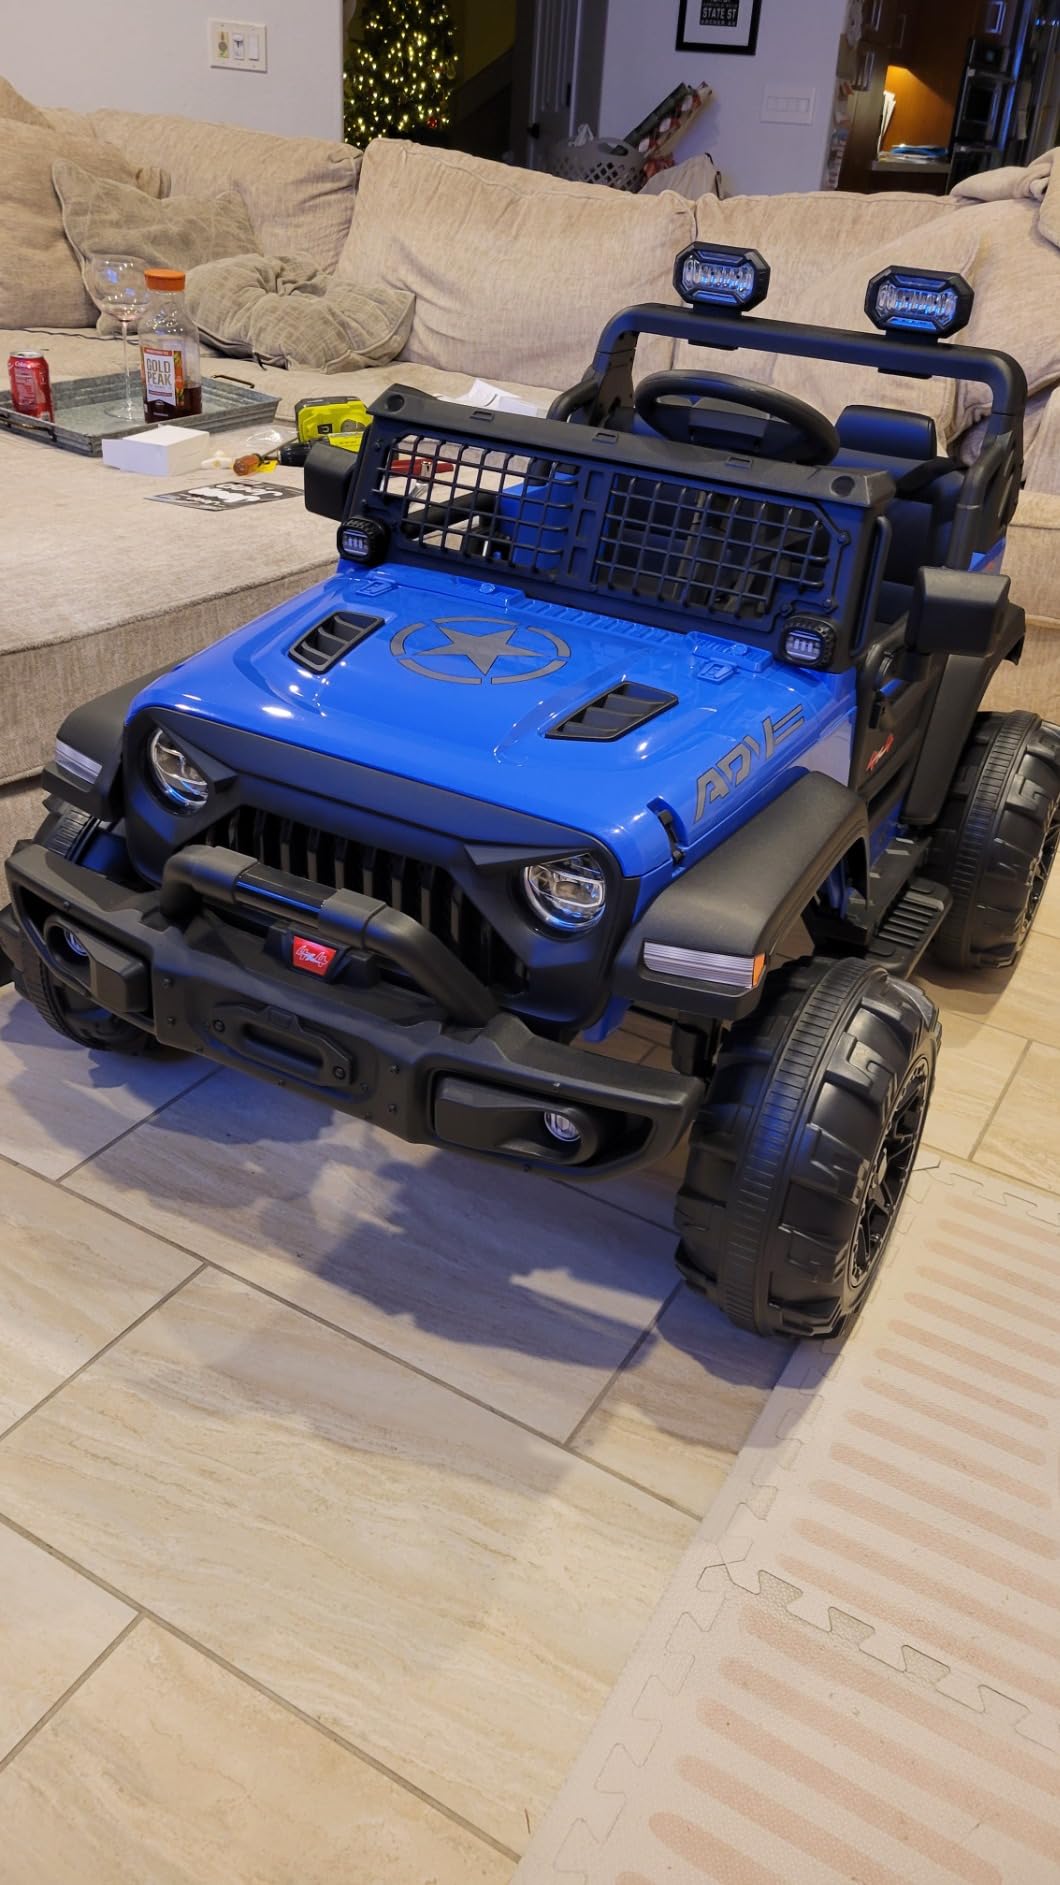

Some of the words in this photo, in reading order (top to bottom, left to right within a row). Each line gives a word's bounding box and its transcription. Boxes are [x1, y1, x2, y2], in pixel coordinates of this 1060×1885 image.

[702, 7, 726, 19] STATE
[727, 8, 737, 20] ST
[146, 358, 171, 374] GOLD
[147, 371, 171, 386] PEAK
